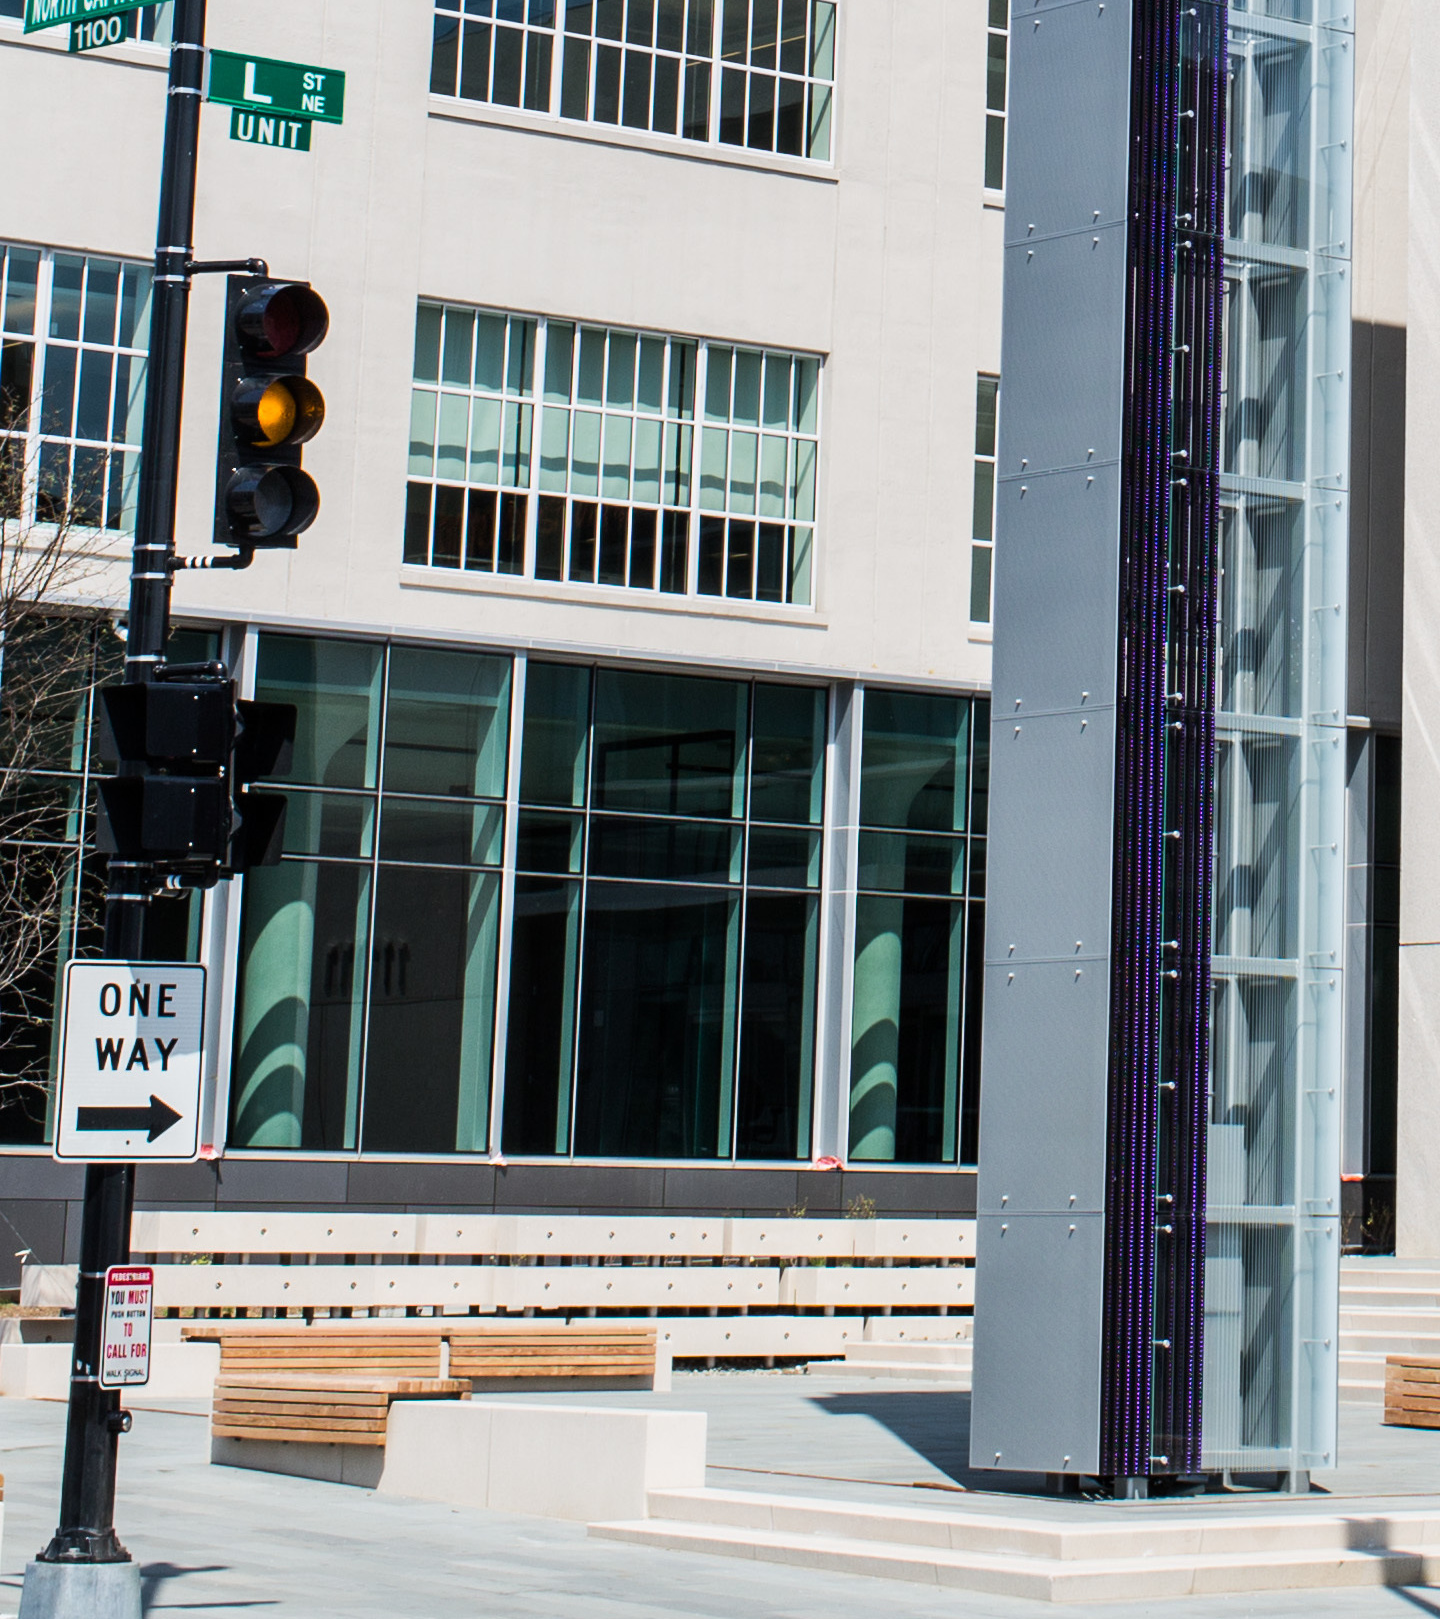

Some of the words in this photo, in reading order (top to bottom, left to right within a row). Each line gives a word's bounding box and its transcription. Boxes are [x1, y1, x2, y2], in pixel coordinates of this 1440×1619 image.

[74, 15, 122, 50] 1100
[243, 61, 273, 104] L
[302, 72, 326, 91] ST
[301, 93, 325, 114] NE
[236, 113, 302, 149] UNIT
[99, 982, 178, 1018] ONE
[95, 1037, 179, 1072] WAY
[111, 1290, 125, 1305] YOU
[127, 1289, 149, 1304] MUST
[110, 1310, 124, 1319] PUSH
[126, 1309, 146, 1318] BUTTON
[124, 1322, 133, 1337] TO
[106, 1343, 127, 1359] CALL
[130, 1343, 147, 1358] FOR
[106, 1369, 122, 1378] WALK
[124, 1368, 145, 1378] SIGNAL
